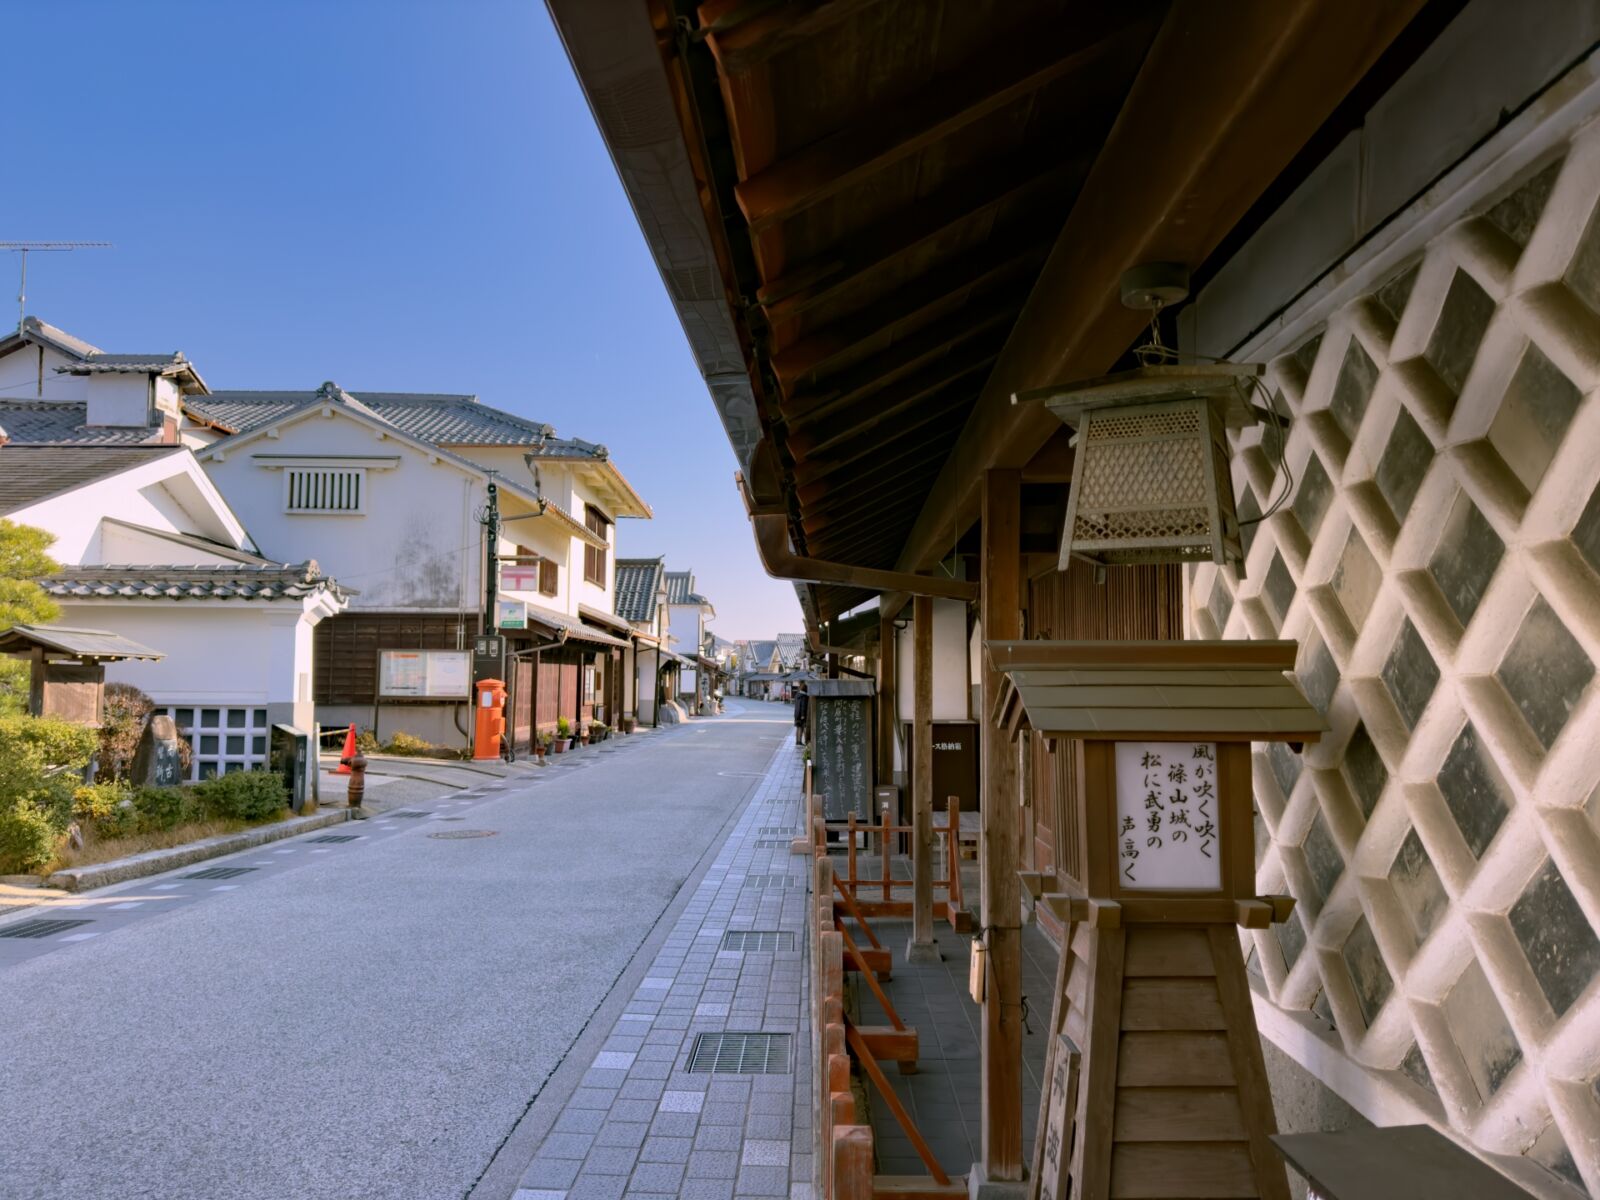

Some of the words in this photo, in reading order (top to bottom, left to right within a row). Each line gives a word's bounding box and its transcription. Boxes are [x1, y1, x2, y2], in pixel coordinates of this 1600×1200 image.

[1141, 751, 1164, 849] 松に武勇の
[1168, 763, 1192, 843] 篠山城の
[1192, 744, 1217, 858] 風が吹く吹く
[1120, 816, 1140, 881] 声高く
